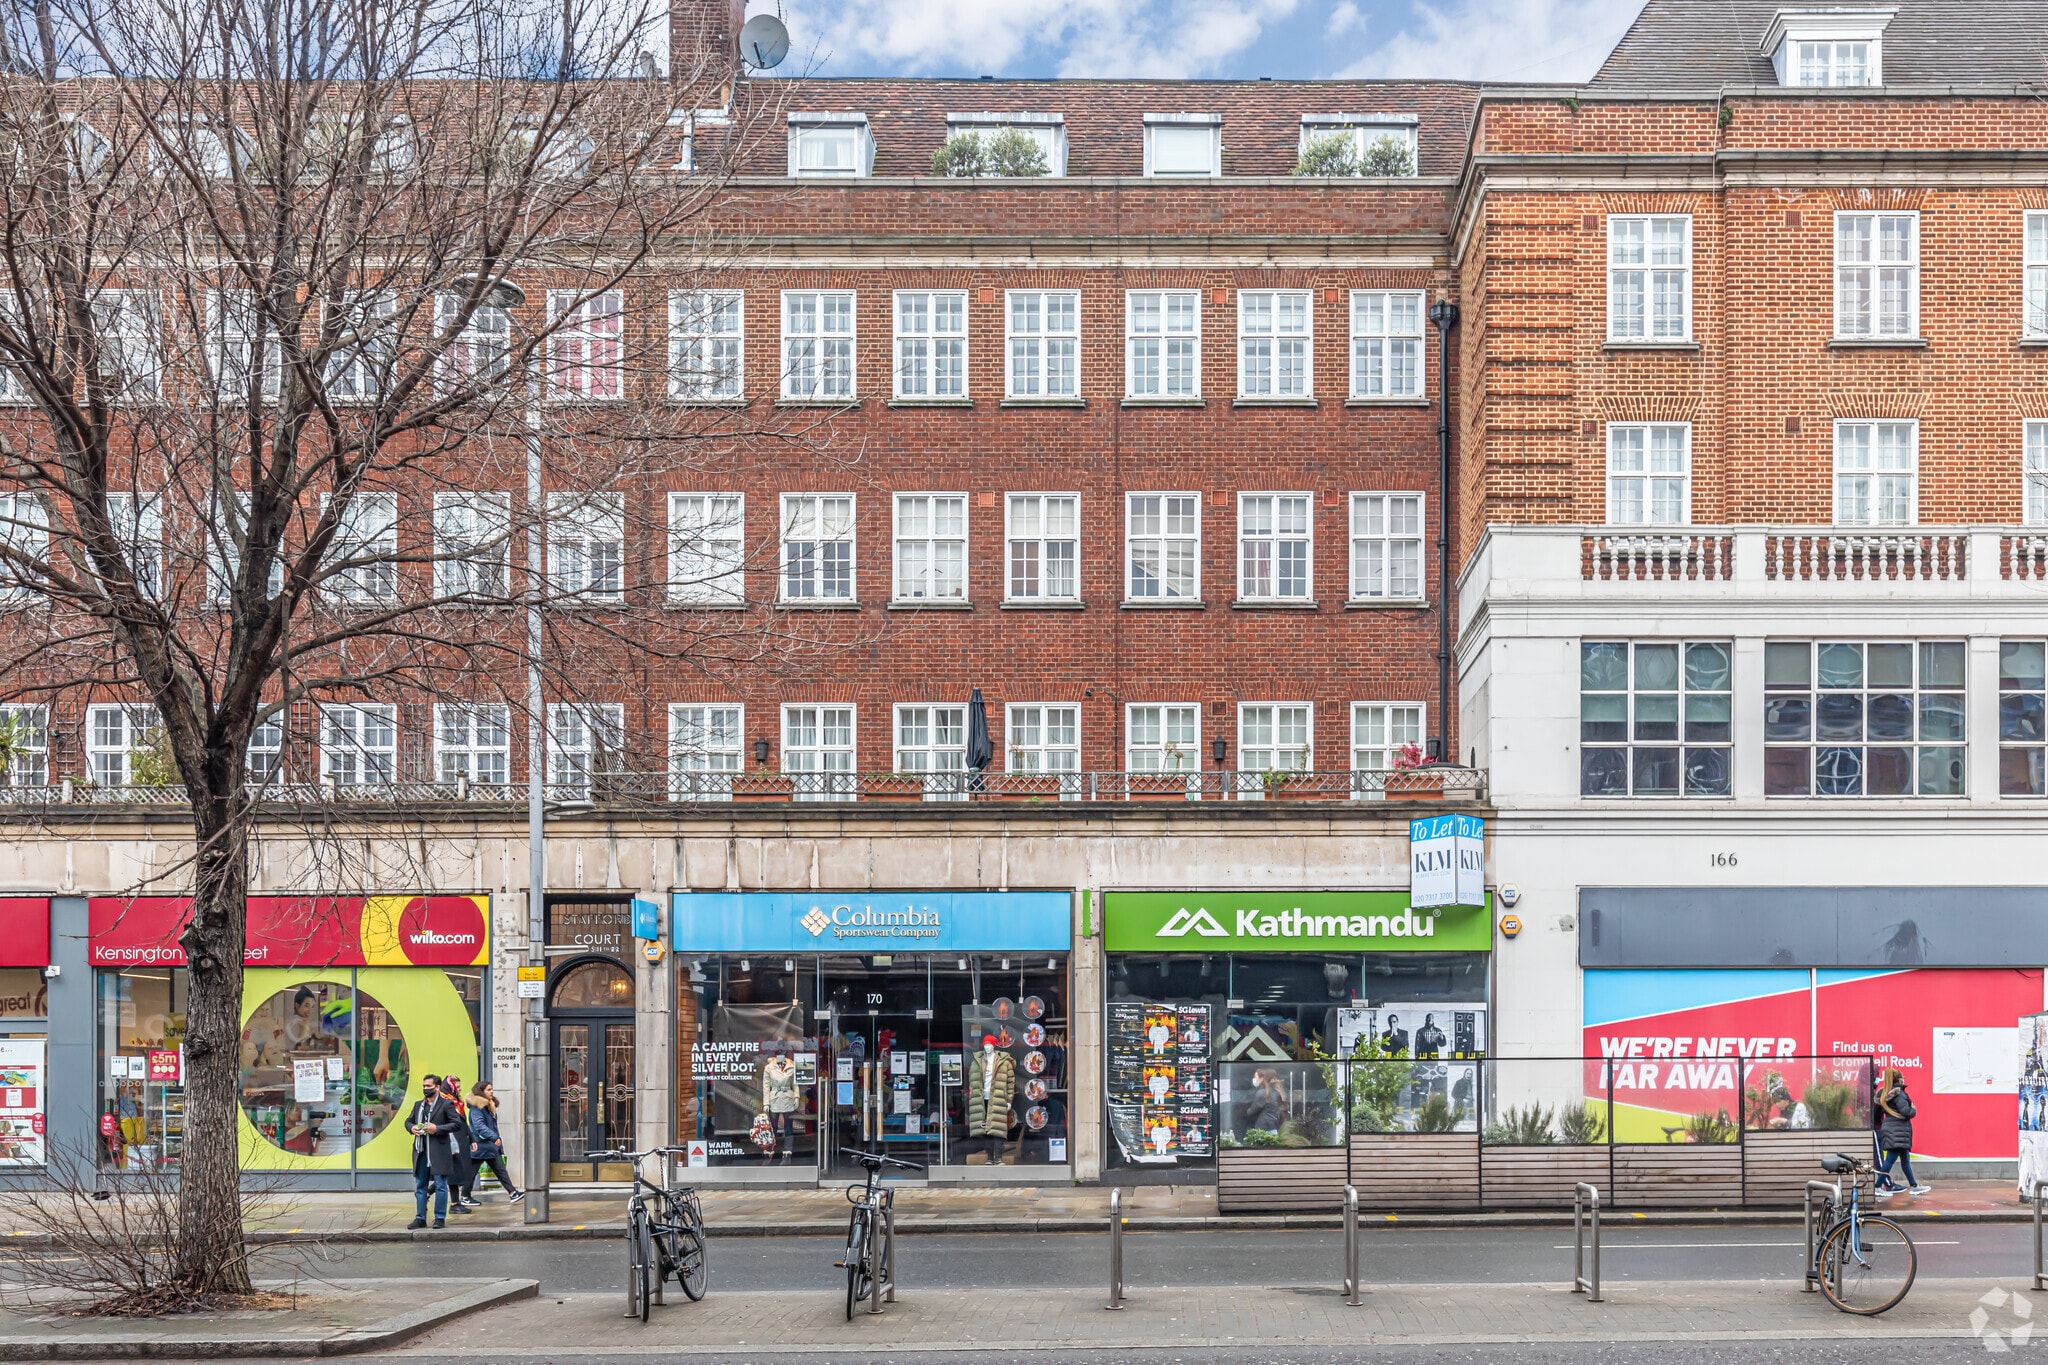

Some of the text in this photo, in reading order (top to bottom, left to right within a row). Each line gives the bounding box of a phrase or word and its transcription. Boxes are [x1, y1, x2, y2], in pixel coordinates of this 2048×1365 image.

[1412, 819, 1454, 840] To Let
[1457, 817, 1484, 839] To Let
[1415, 849, 1451, 873] KLM
[1711, 851, 1738, 867] 166
[563, 914, 631, 925] STAFFORD
[831, 905, 940, 926] Columbia
[1236, 907, 1434, 937] Kathmandu
[409, 930, 475, 944] wilko.com
[574, 934, 621, 945] COURT
[833, 927, 941, 940] Sportswear Company
[95, 945, 182, 963] Kensington
[866, 993, 883, 1004] 170
[1178, 1006, 1188, 1014] SG
[1189, 1006, 1207, 1014] Lewis
[691, 1042, 760, 1052] A CAMPFIRE
[1695, 1037, 1797, 1063] NEVER
[1832, 1041, 1893, 1053] Find us on
[152, 1053, 177, 1064] £5m
[691, 1053, 741, 1062] IN EVERY
[1178, 1056, 1188, 1064] SG
[1189, 1055, 1207, 1064] Lewis
[1890, 1056, 1923, 1068] Road,
[691, 1063, 757, 1072] SILVER DOT.
[1599, 1064, 1754, 1089] FAR AWAY
[1180, 1106, 1190, 1114] SG
[1191, 1105, 1209, 1114] Lewis
[708, 1141, 733, 1149] WARM
[708, 1148, 745, 1156] SMARTER.
